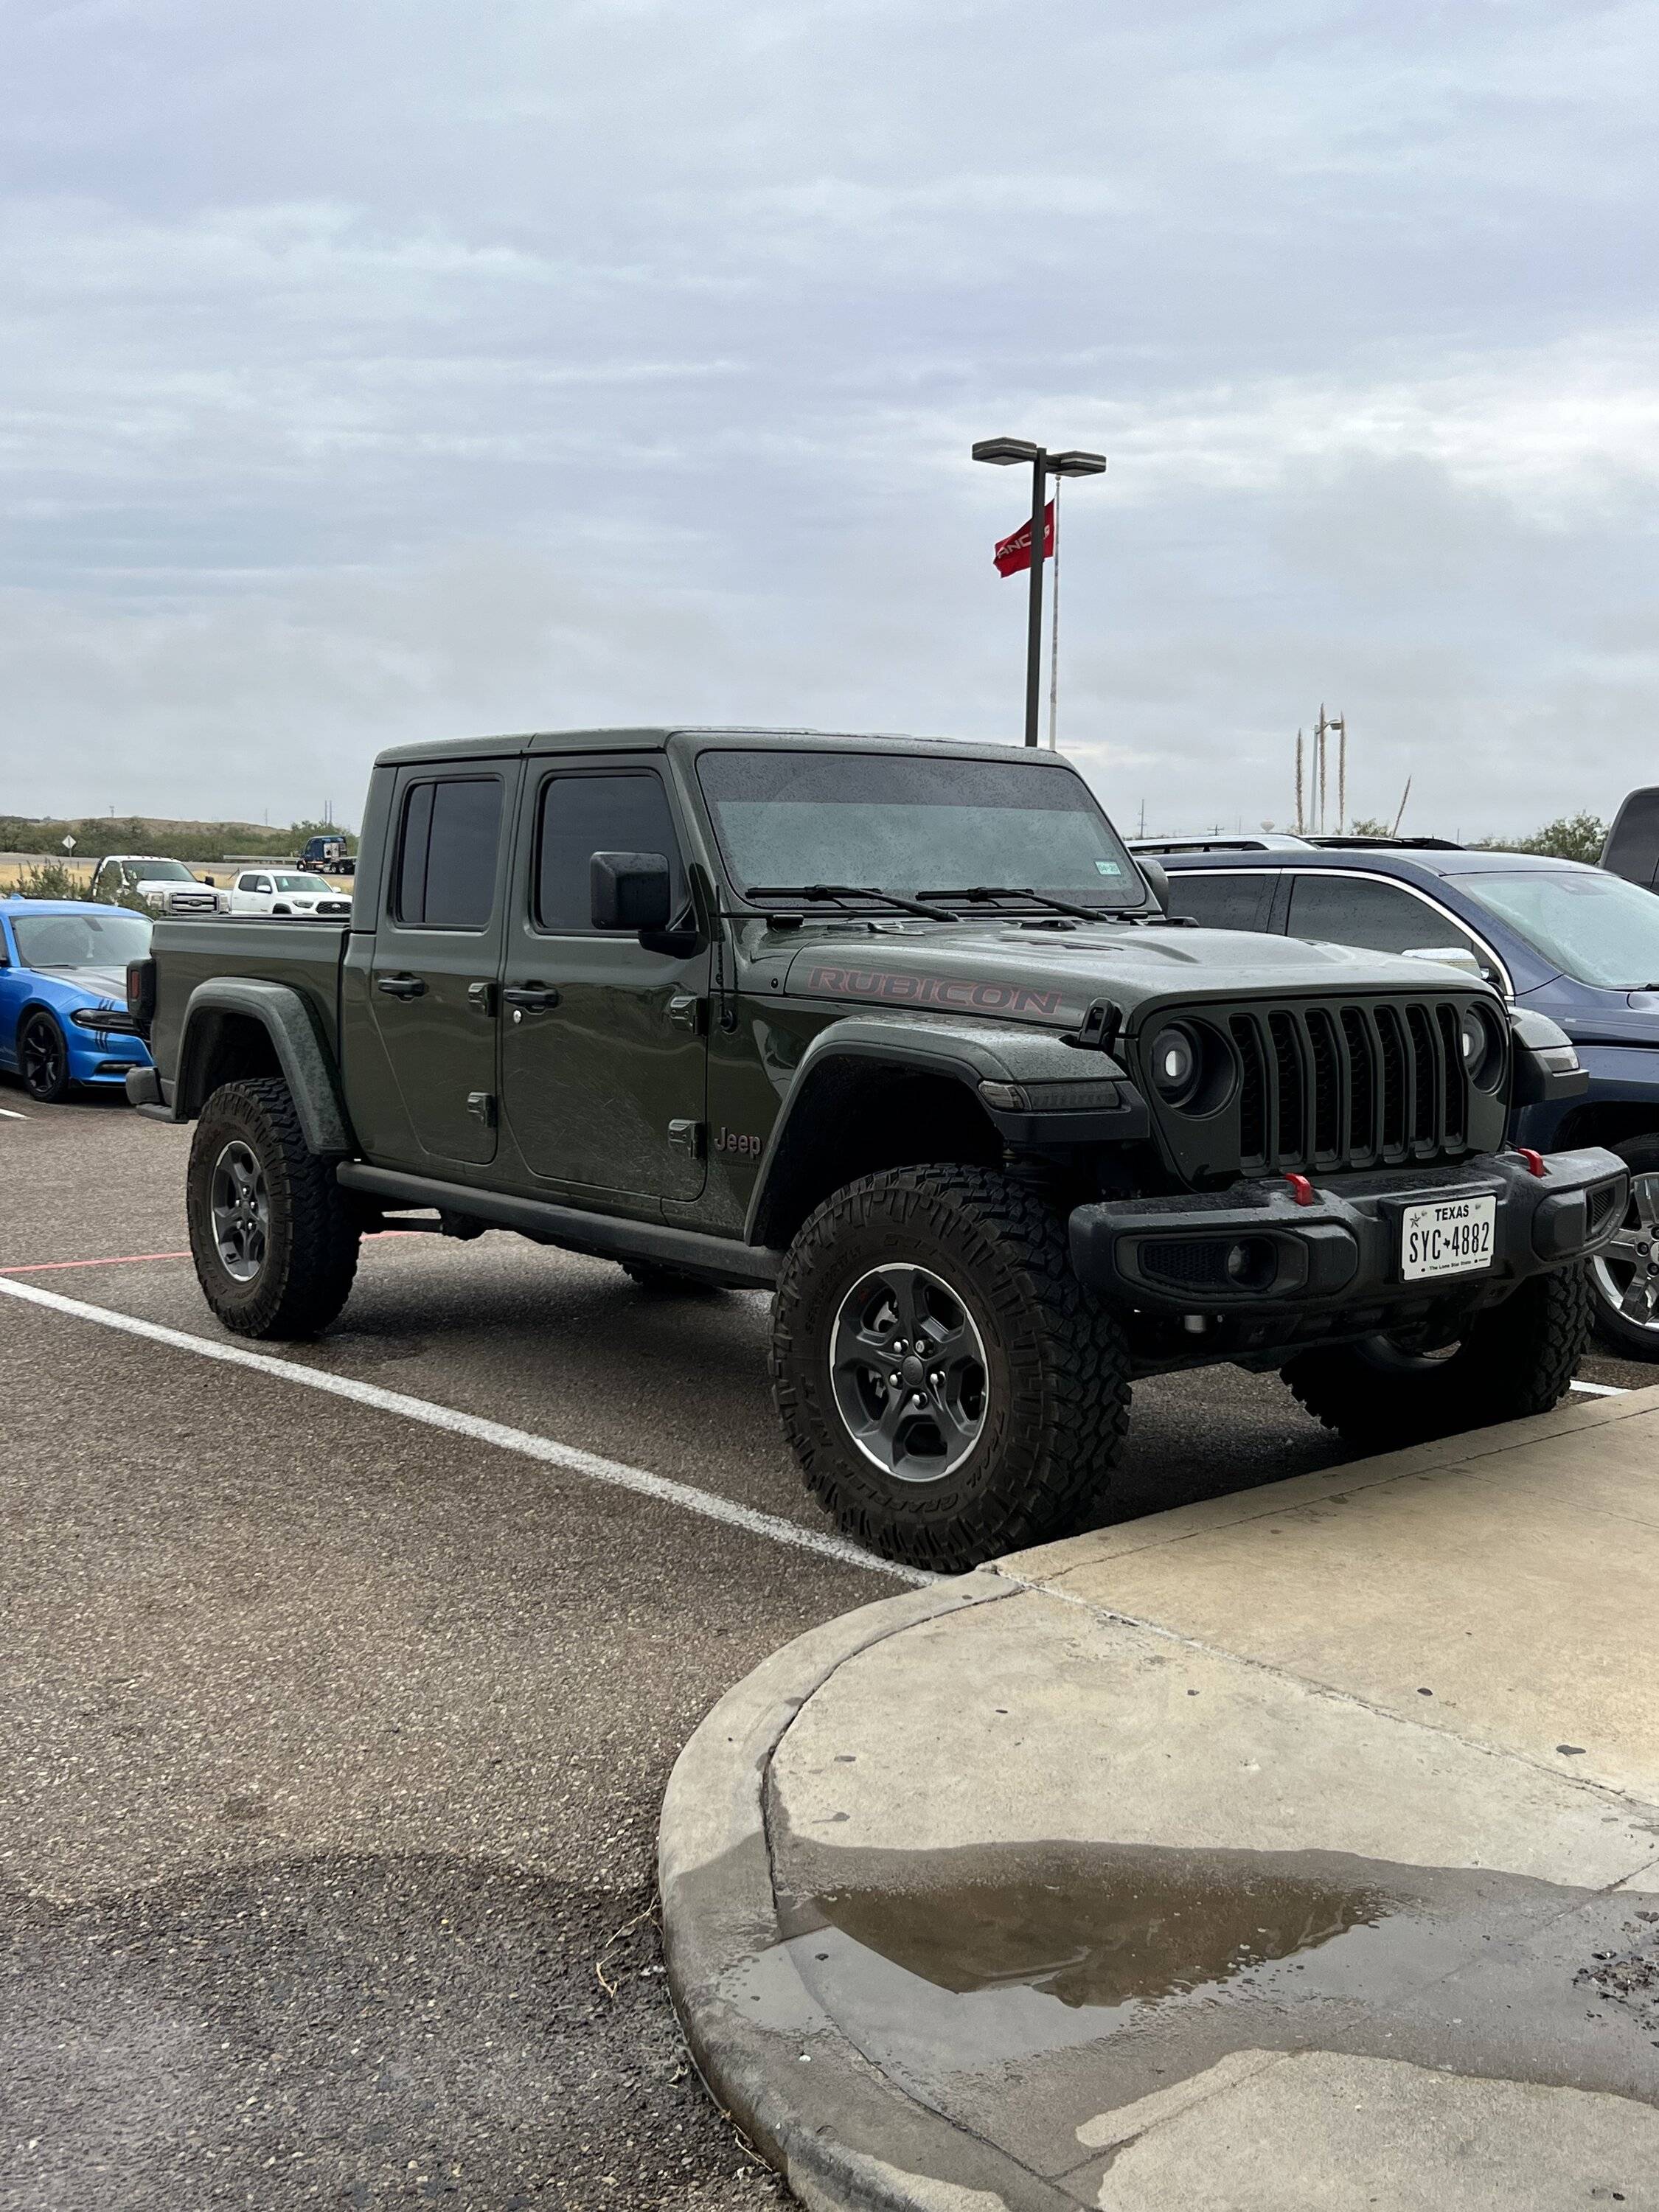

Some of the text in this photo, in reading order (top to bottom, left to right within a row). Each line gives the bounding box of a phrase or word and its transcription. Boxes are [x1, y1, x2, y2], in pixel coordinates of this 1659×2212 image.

[808, 966, 1062, 1016] RUBICON
[714, 1127, 761, 1160] Jeep
[1435, 1204, 1470, 1221] TEXAS
